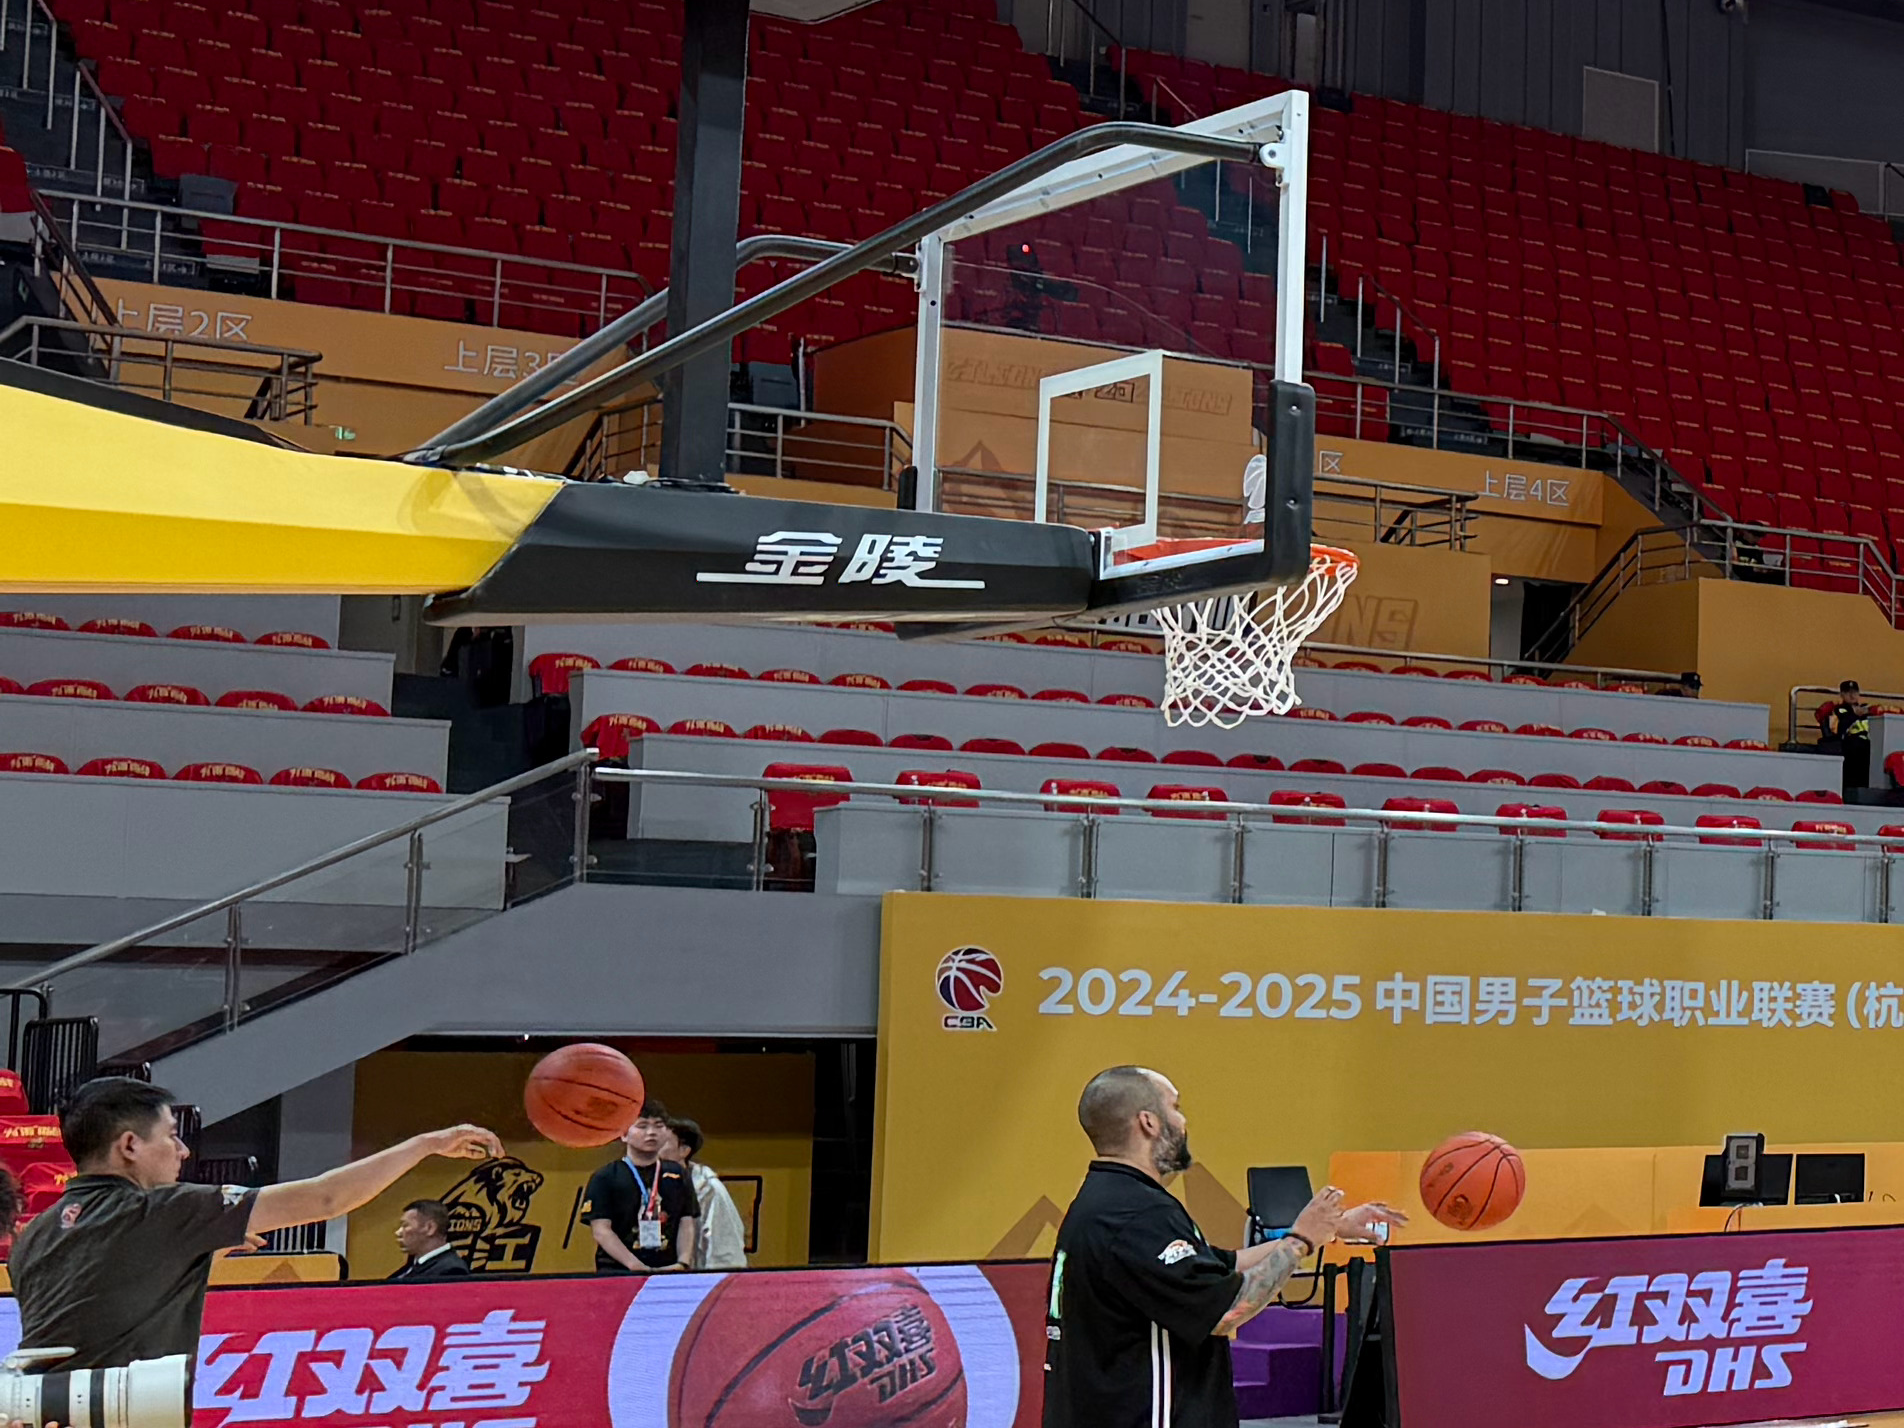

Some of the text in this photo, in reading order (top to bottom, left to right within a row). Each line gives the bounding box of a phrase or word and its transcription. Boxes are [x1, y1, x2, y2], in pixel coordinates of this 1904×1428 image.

[1479, 468, 1572, 506] 上层4区
[696, 530, 985, 589] 金陵
[1037, 965, 1363, 1021] 2024-2025
[941, 1014, 998, 1031] CBA
[1530, 1258, 1816, 1362] 红双喜
[1663, 1343, 1809, 1396] DHS
